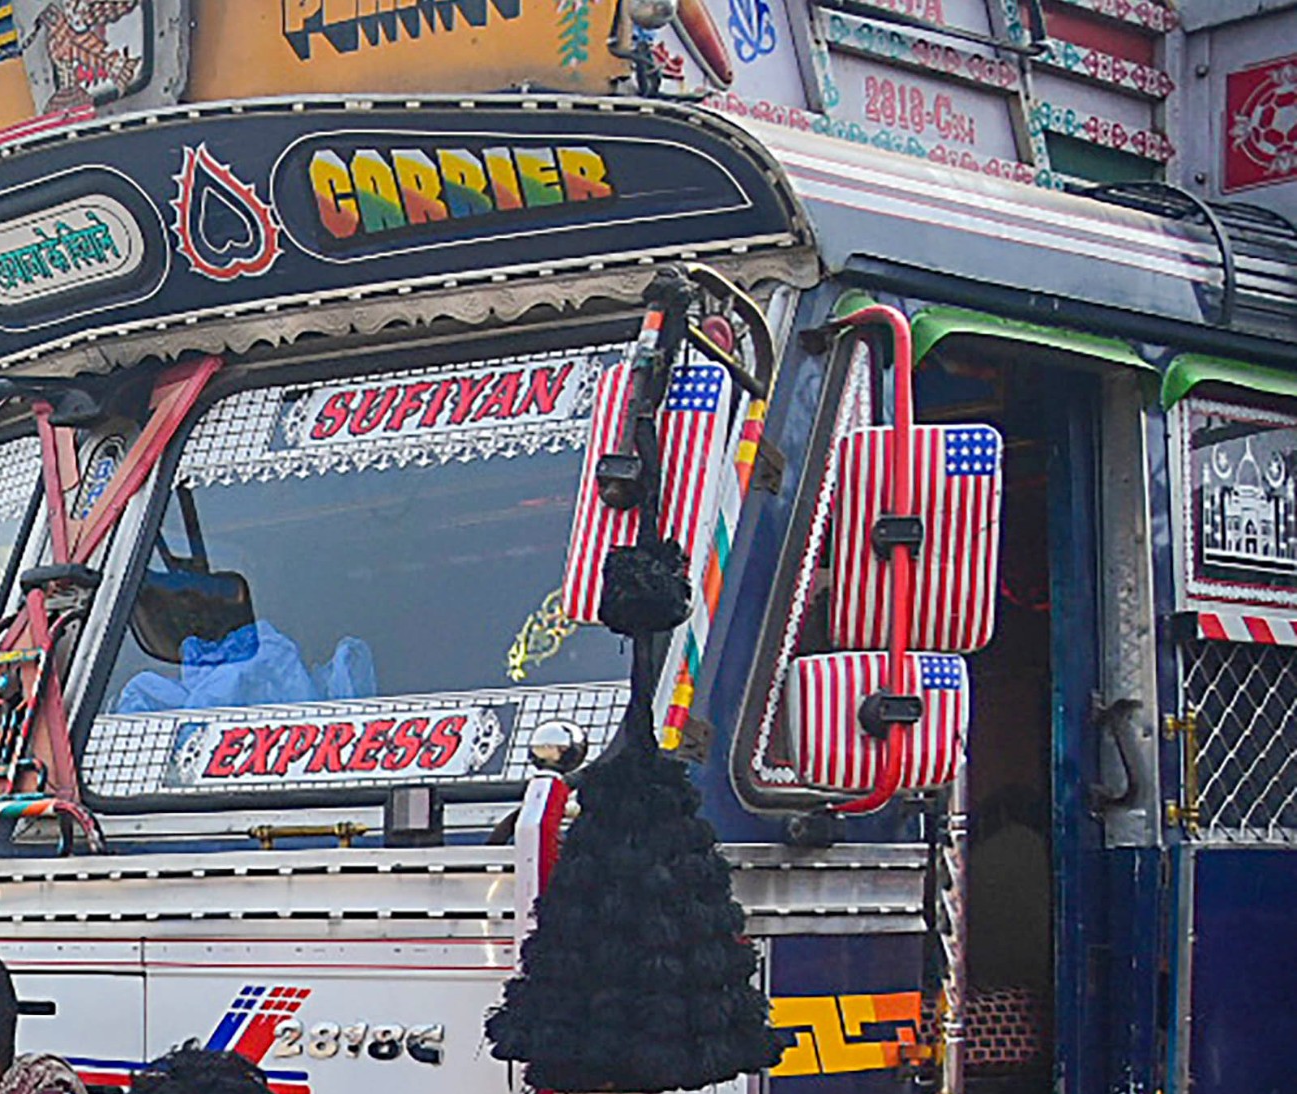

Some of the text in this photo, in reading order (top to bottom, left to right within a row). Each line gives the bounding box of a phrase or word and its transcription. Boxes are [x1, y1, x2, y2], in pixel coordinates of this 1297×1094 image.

[309, 148, 614, 240] CARRIER
[310, 361, 575, 441] SUFIYAN
[203, 715, 469, 779] EXPRESS
[274, 1017, 445, 1067] 2818C
